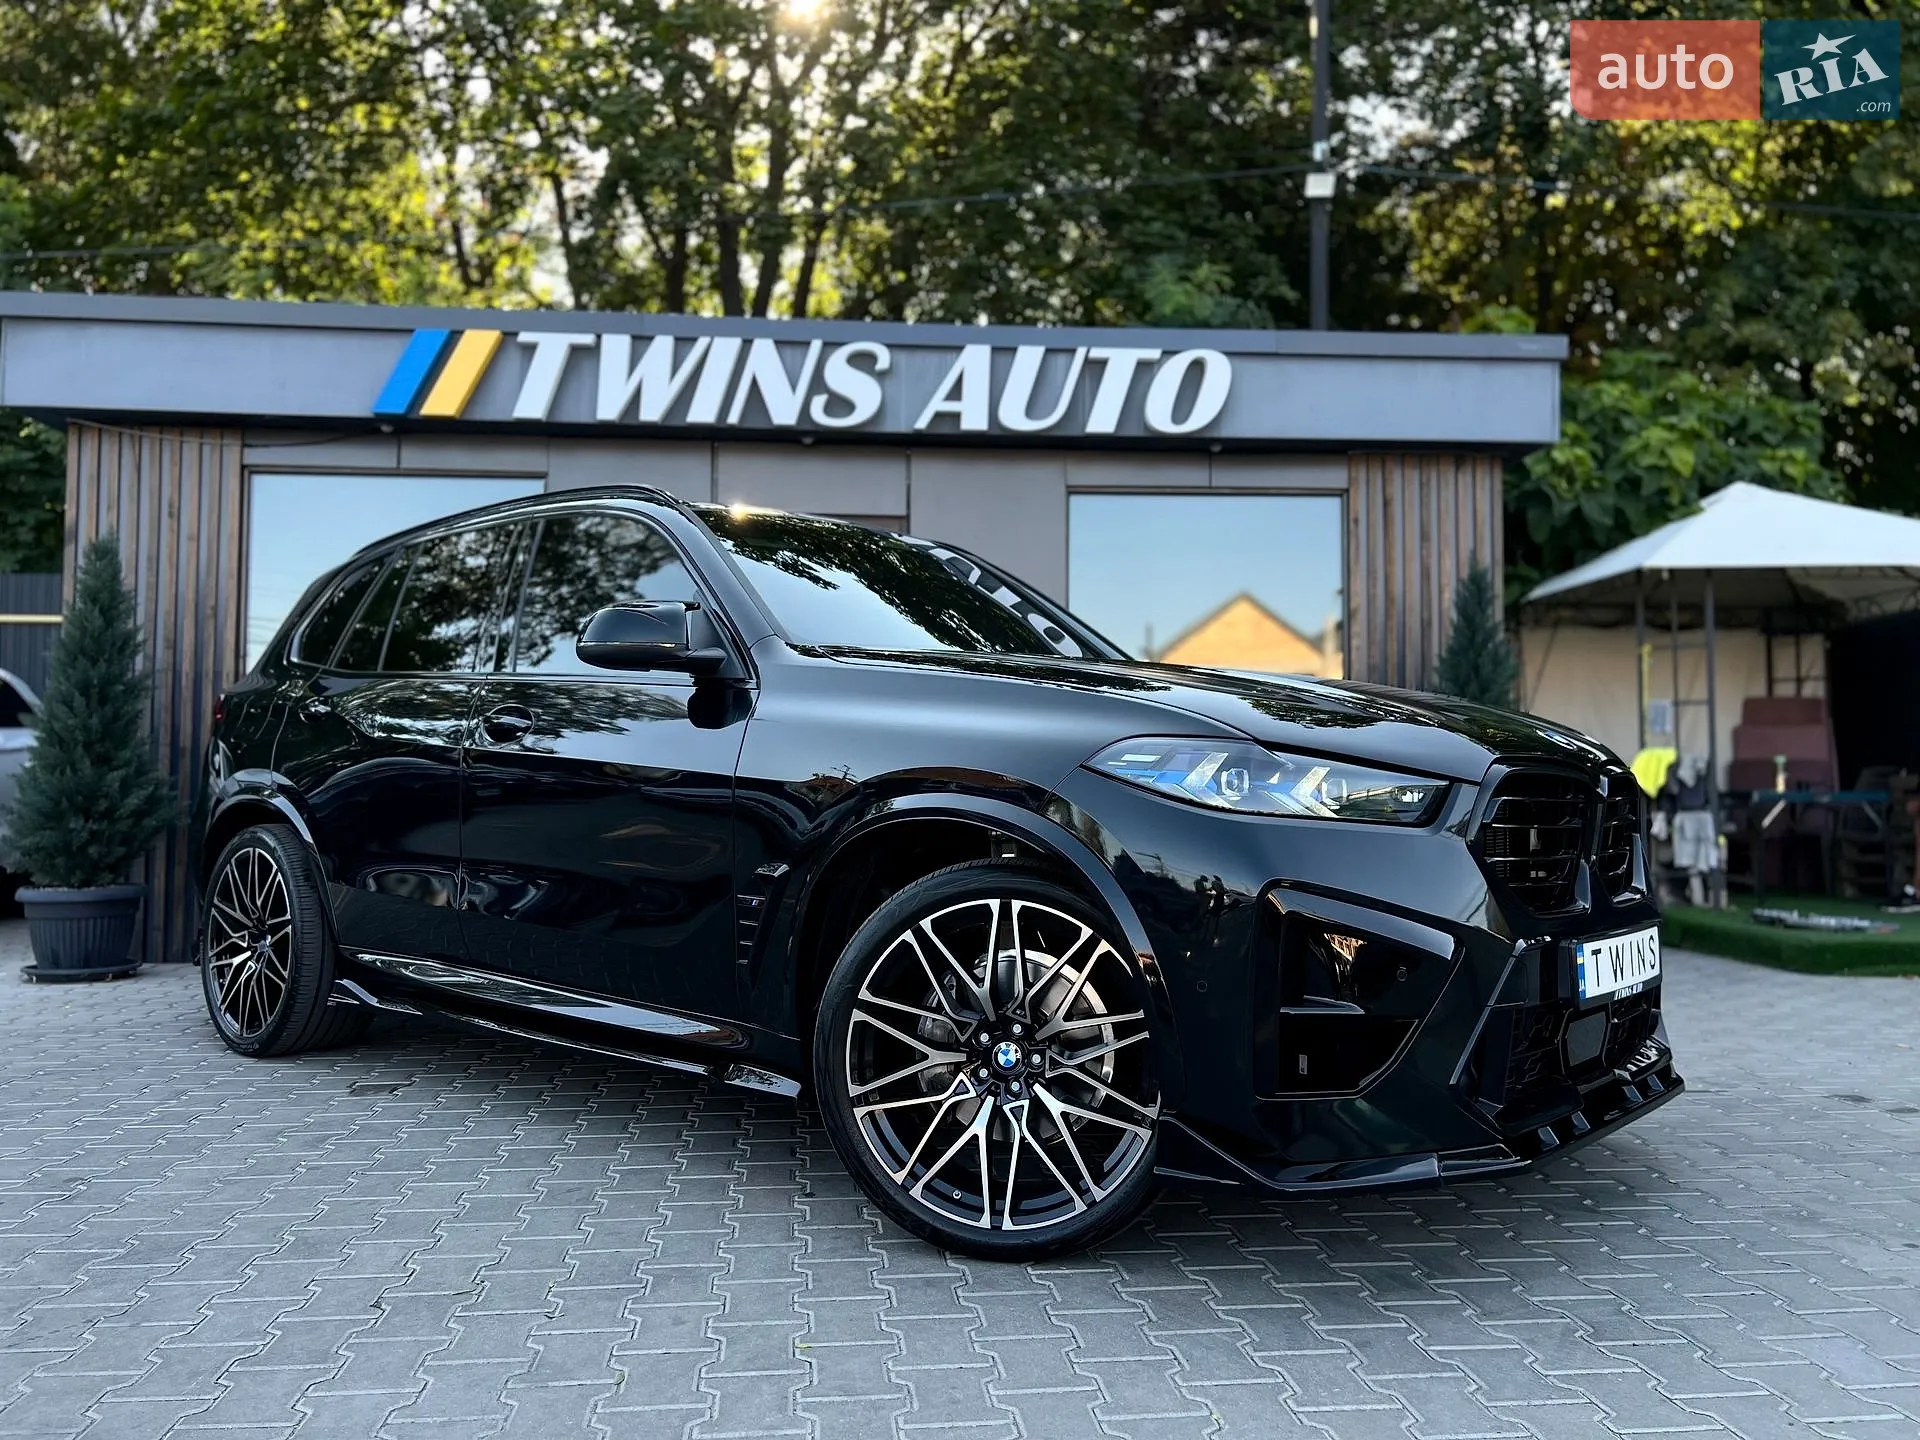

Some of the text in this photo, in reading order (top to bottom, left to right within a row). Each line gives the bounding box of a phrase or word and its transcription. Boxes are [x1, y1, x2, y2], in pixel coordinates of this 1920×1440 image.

[511, 331, 1232, 434] TWINS AUTO
[1591, 934, 1656, 988] TWINS
